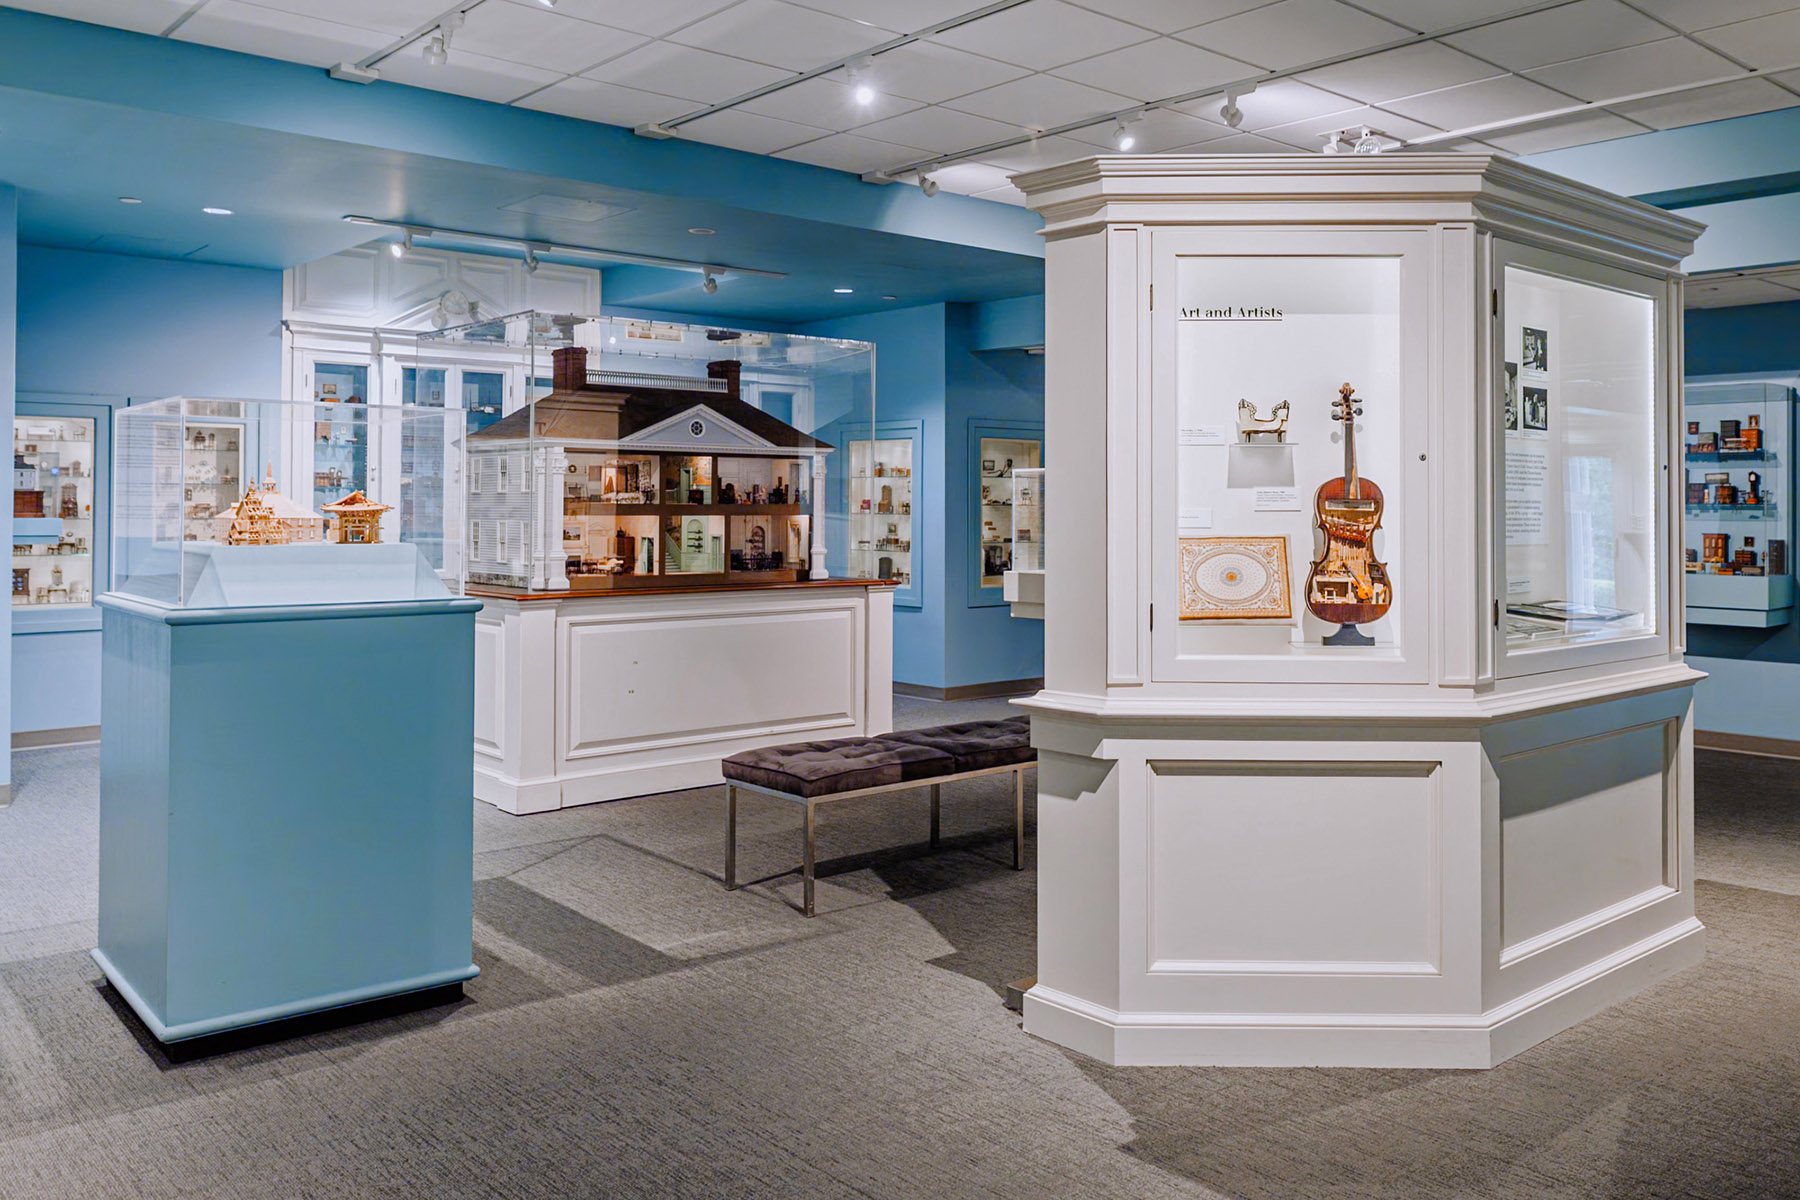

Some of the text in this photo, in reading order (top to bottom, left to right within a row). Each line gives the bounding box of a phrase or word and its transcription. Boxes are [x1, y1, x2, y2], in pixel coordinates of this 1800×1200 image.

[1180, 306, 1283, 318] Art and Artists
